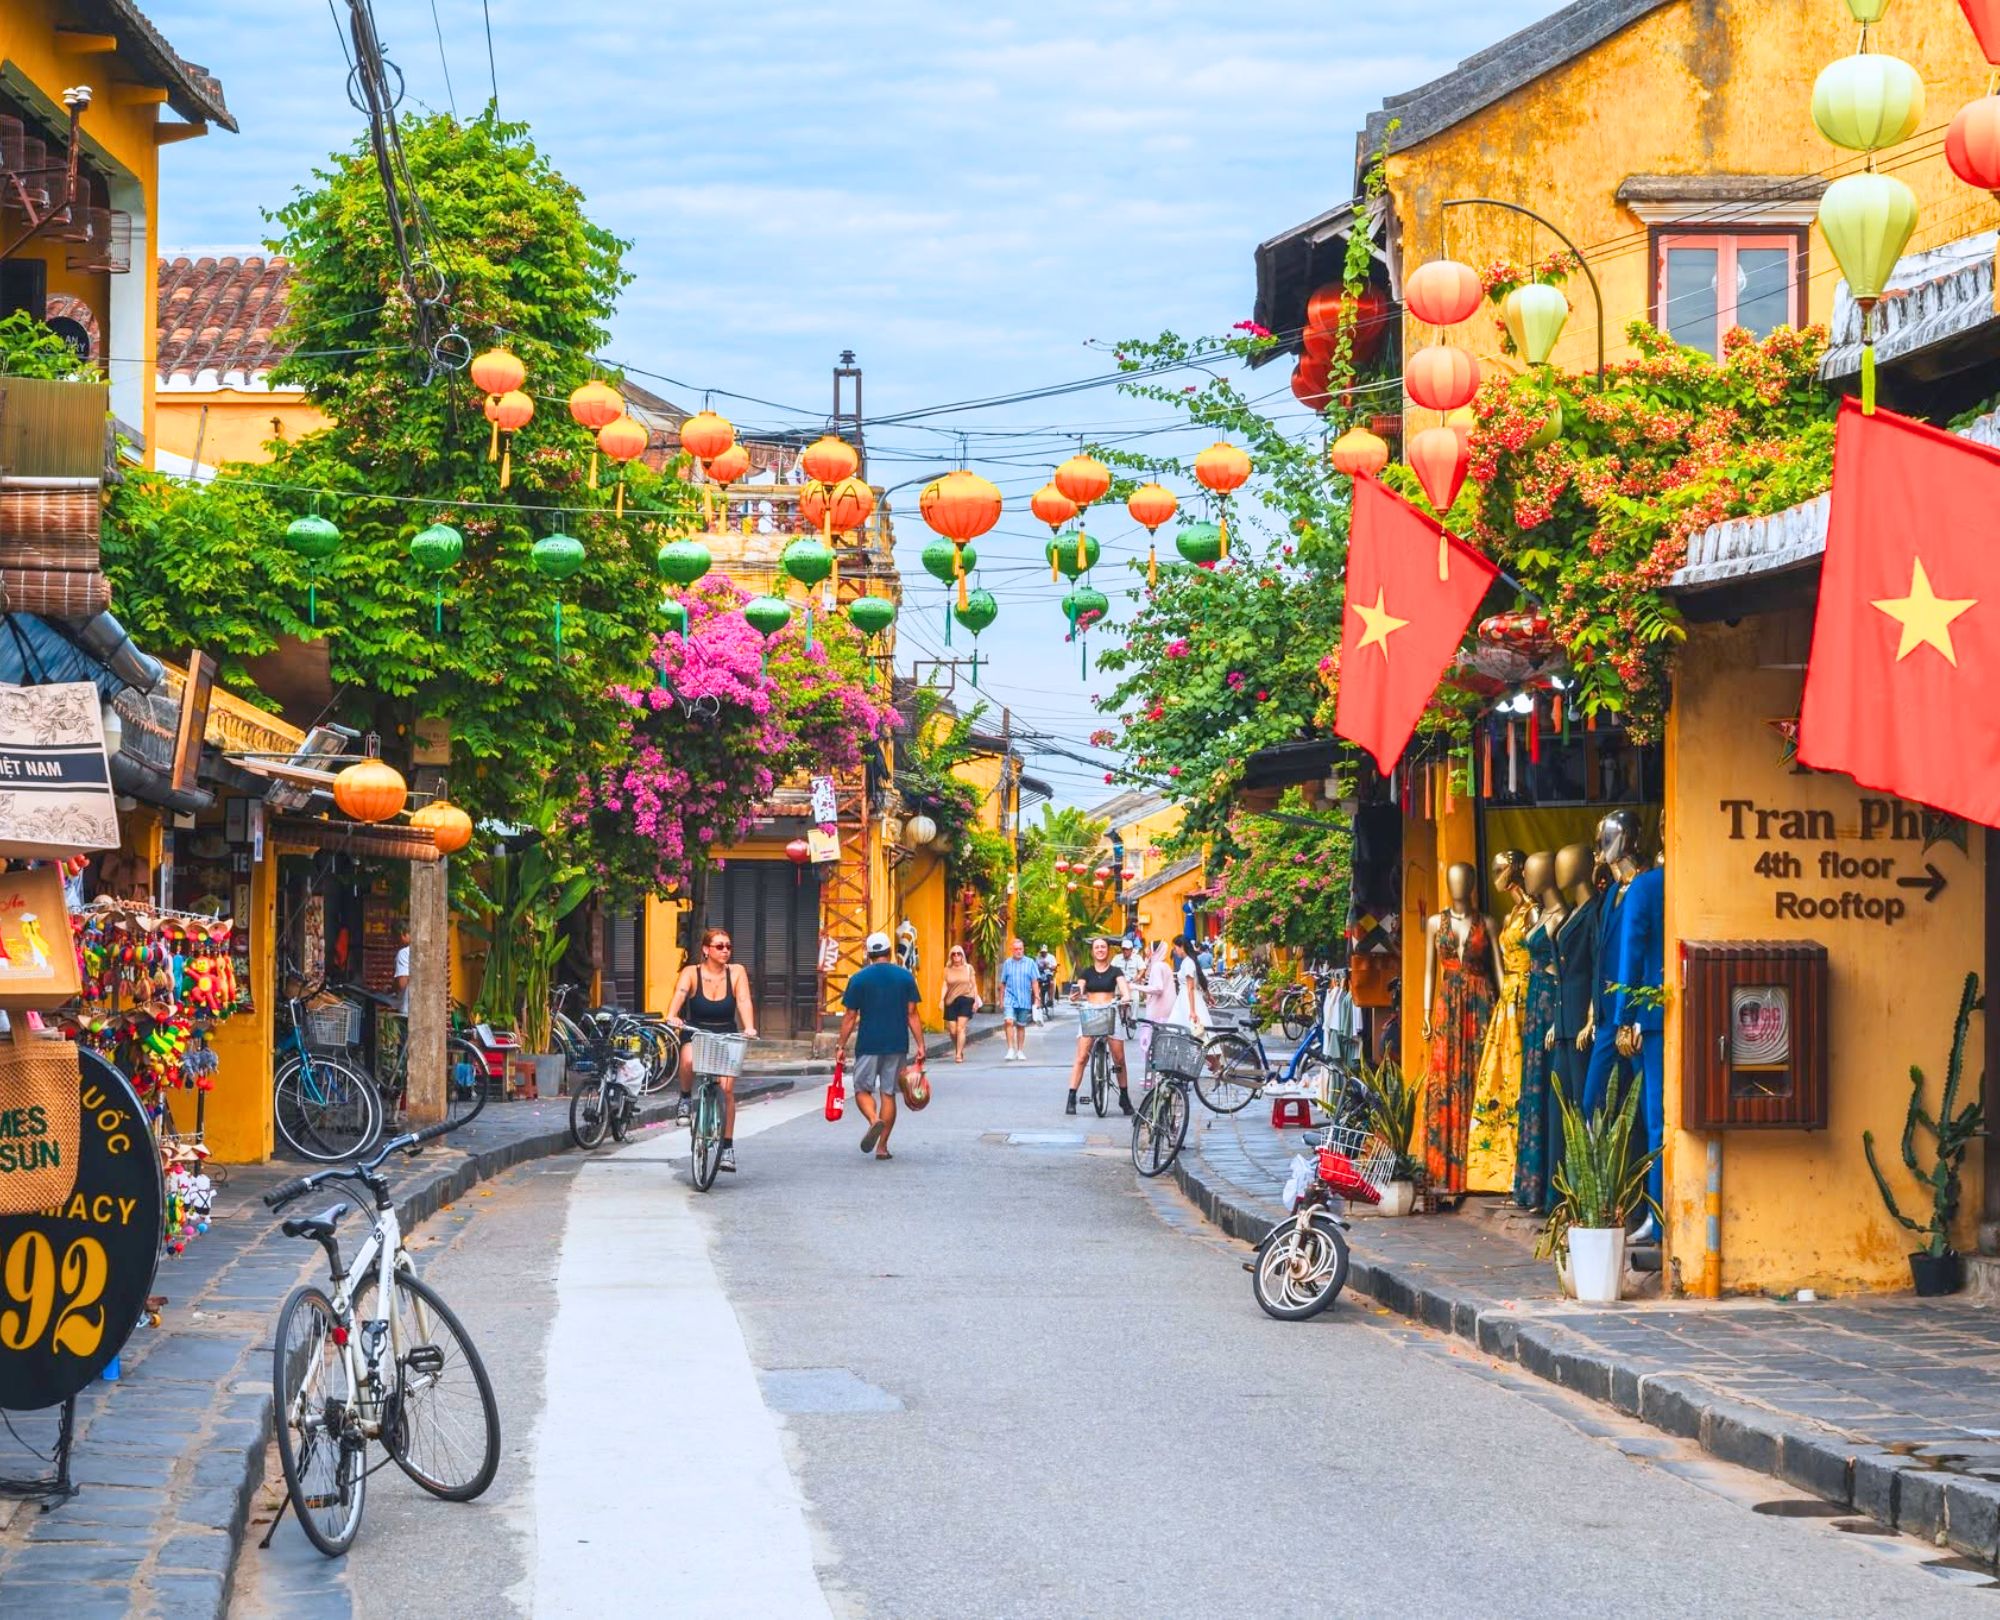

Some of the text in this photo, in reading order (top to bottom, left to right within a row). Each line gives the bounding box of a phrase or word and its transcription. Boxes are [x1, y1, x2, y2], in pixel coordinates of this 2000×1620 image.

[25, 760, 63, 776] NAM
[1719, 799, 1837, 840] Tran
[1754, 851, 1896, 878] 4th floor
[1775, 891, 1906, 926] Rooftop
[823, 937, 839, 971] ATM
